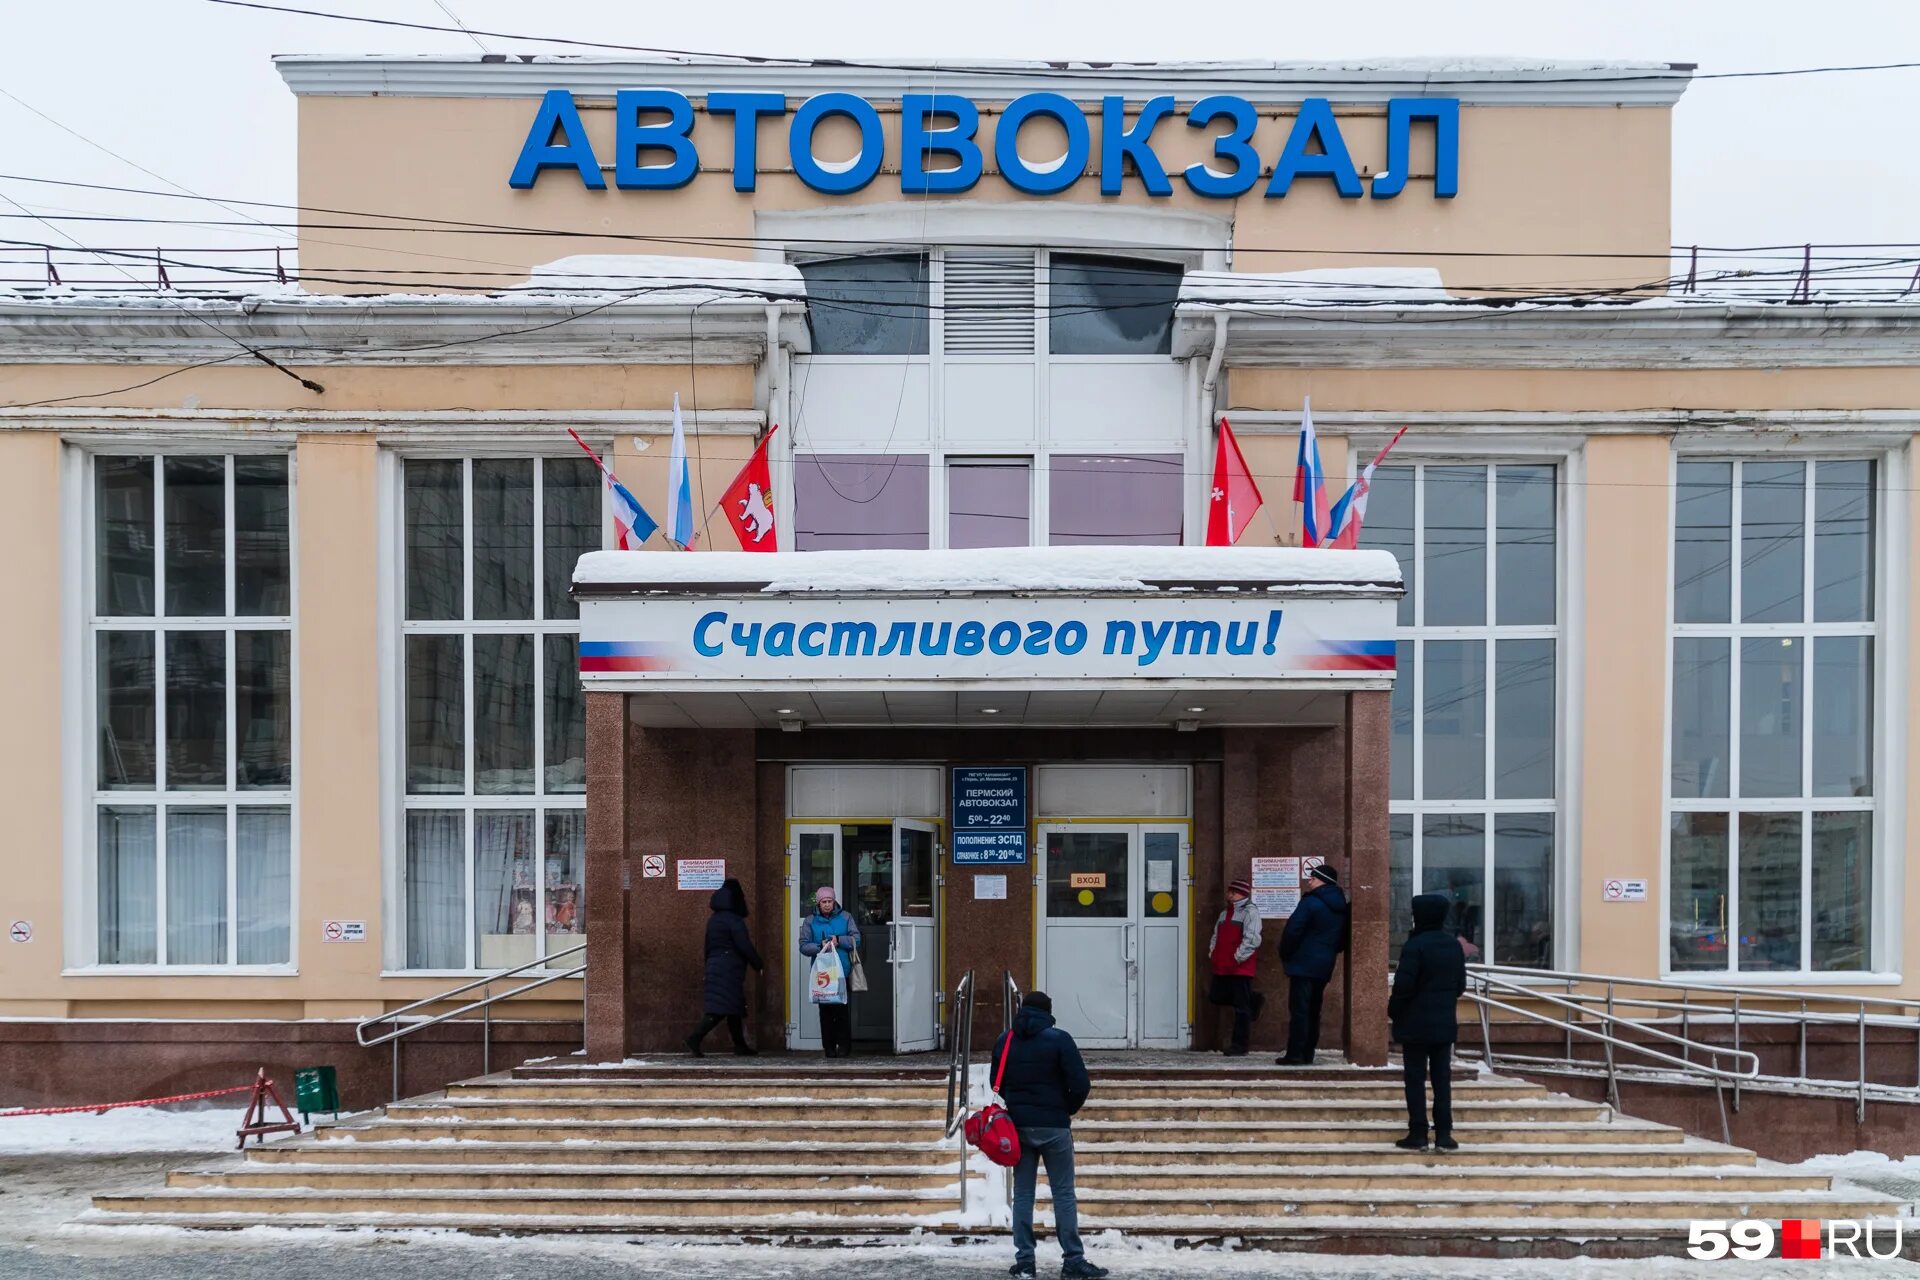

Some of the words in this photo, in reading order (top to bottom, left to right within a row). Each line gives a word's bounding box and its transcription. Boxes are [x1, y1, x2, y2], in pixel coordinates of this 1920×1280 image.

[509, 88, 1460, 199] АВТОВОКЗАЛ
[691, 610, 1089, 658] Счастливого
[1101, 609, 1284, 667] пути!
[966, 788, 1014, 797] ПЕРМСКИЙ
[959, 799, 1018, 807] АВТОВОКЗАЛ
[957, 836, 997, 845] ПОПОЛНЕНИЕ
[998, 835, 1022, 846] ЭСПД
[1077, 876, 1100, 884] ВХОД
